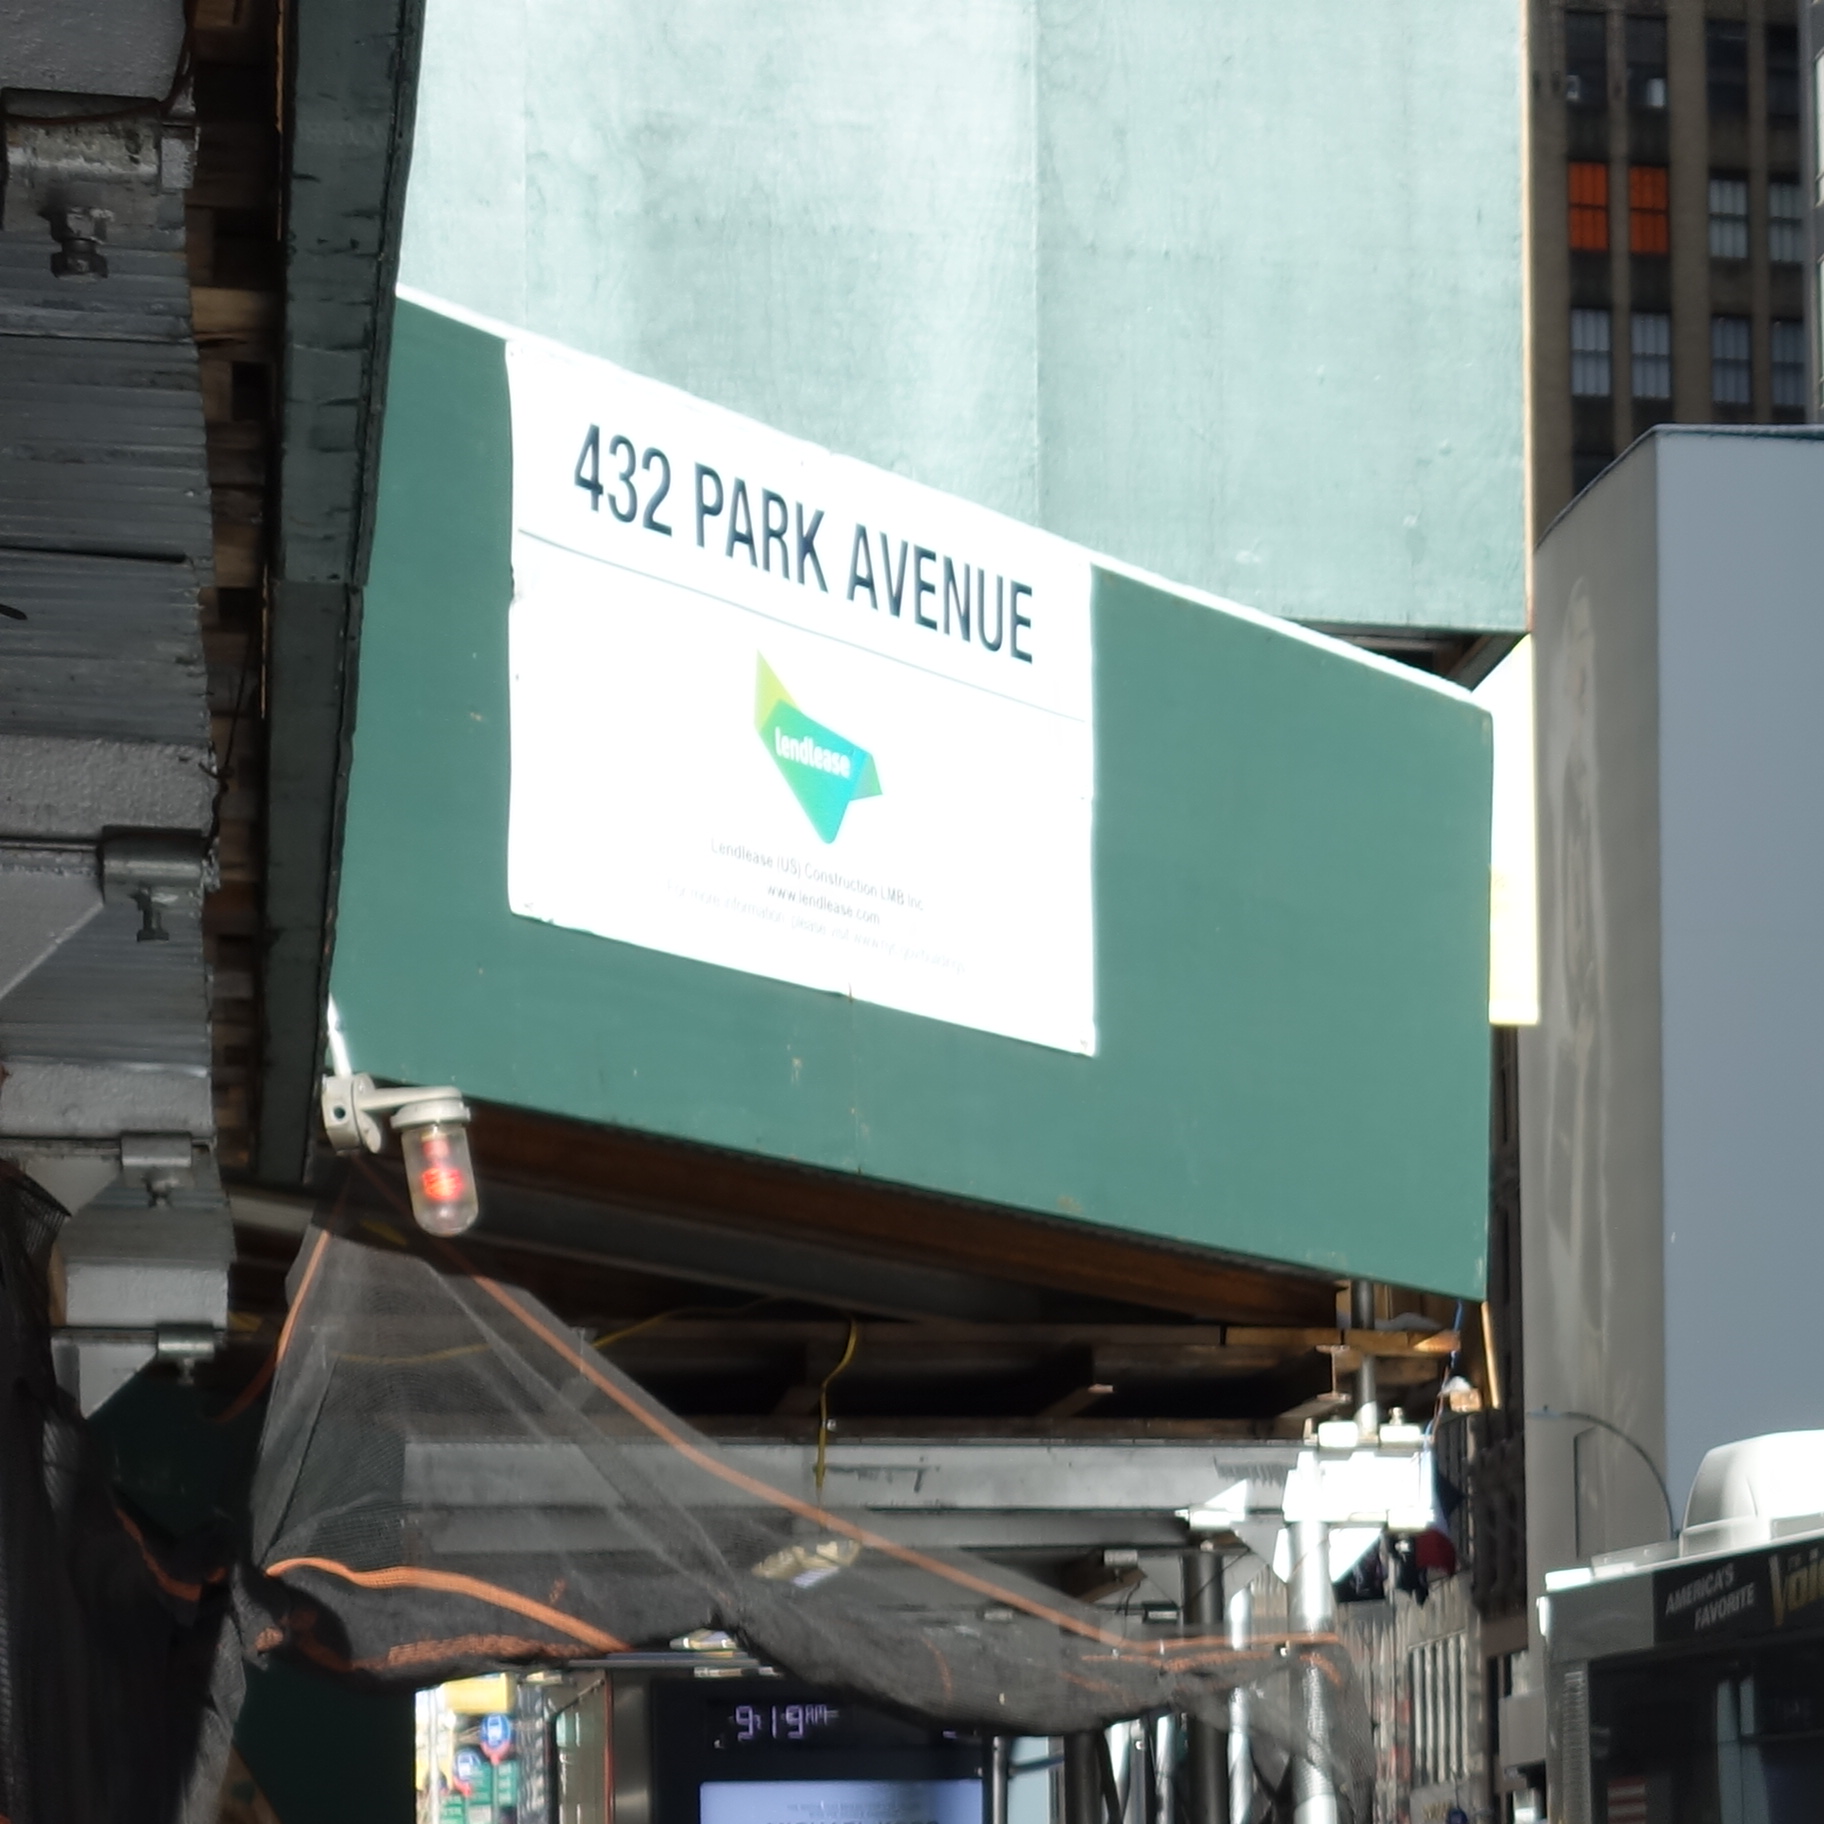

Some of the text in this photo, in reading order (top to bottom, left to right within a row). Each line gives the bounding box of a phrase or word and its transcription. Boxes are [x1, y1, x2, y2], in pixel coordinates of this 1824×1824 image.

[574, 423, 1033, 665] 432 PARK AVENUE
[774, 725, 852, 780] lendlease
[710, 837, 774, 869] Lendlease
[776, 855, 801, 879] (US)
[804, 862, 878, 898] Construction
[879, 885, 906, 907] LMB
[766, 885, 881, 925] www.lendlease.com
[1665, 1562, 1736, 1618] AMERICA'S
[1694, 1581, 1756, 1632] FAVORITE
